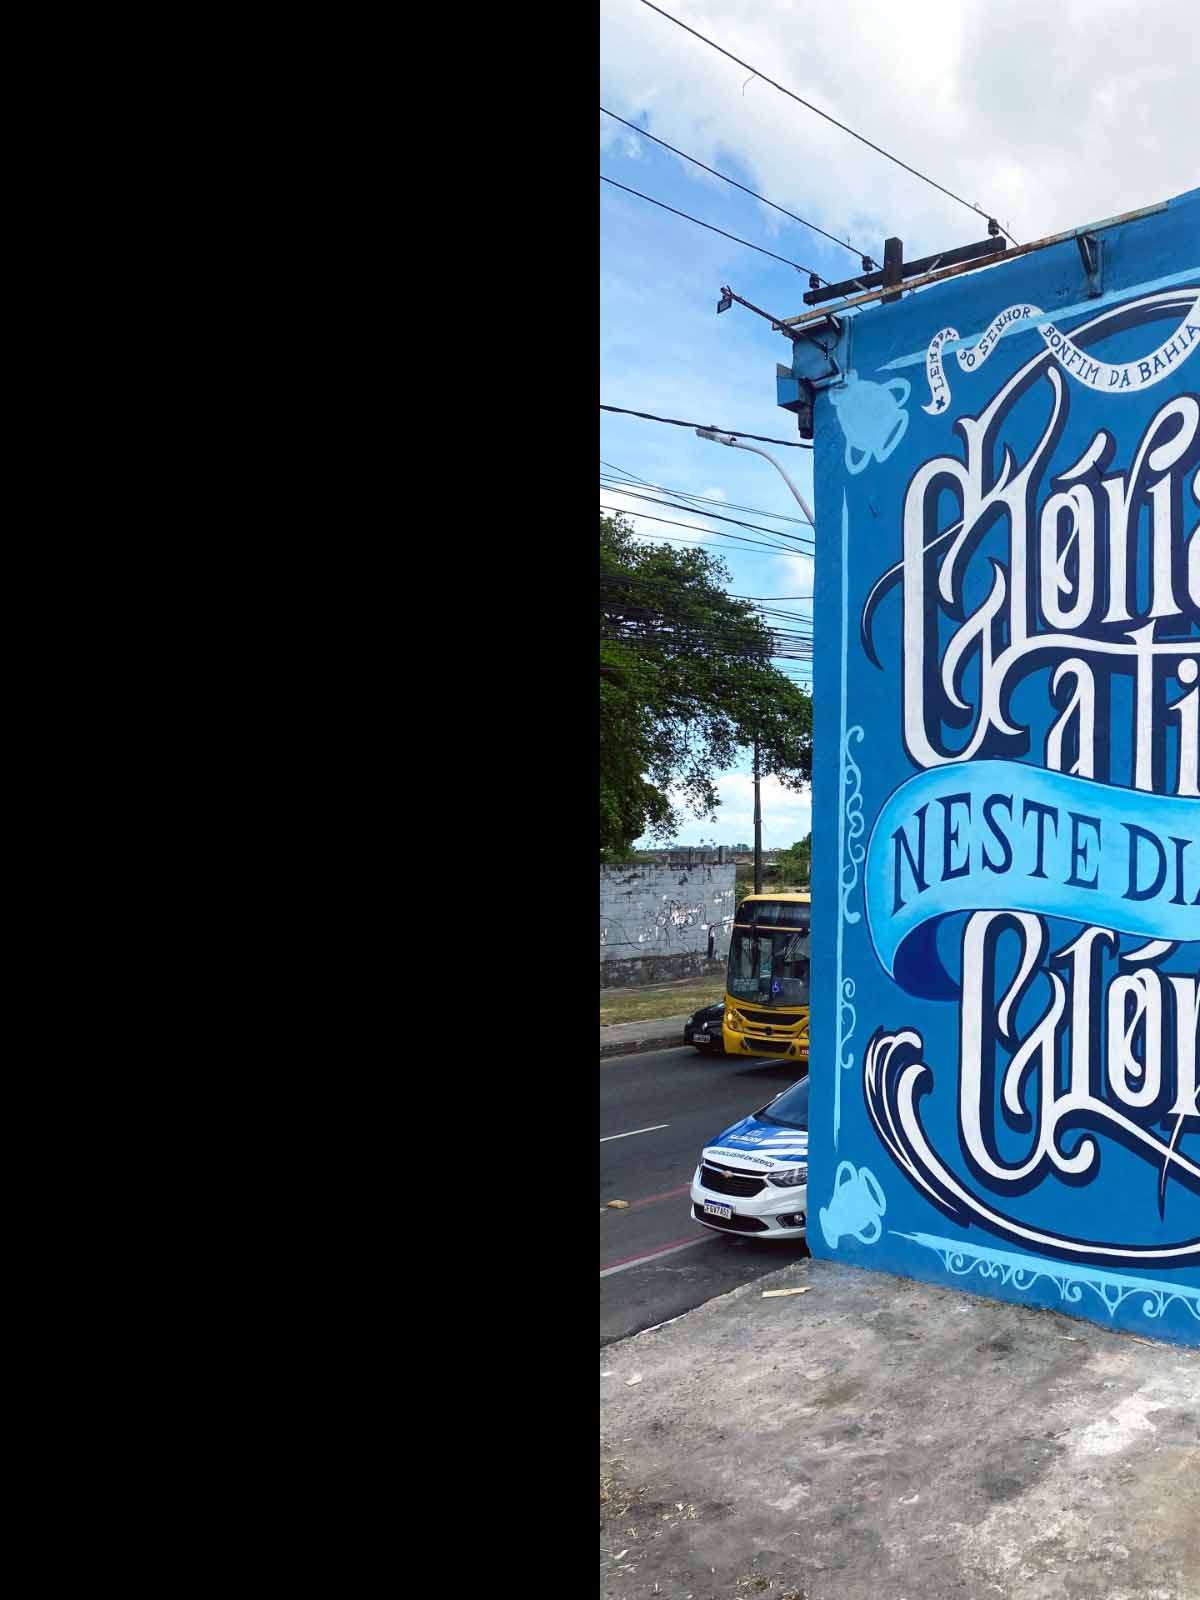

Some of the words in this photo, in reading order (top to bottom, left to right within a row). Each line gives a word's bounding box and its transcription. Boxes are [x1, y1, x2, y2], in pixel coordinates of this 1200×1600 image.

[978, 306, 1031, 356] SENHOR
[1044, 326, 1100, 385] BONFIM
[1107, 369, 1131, 388] DA
[890, 791, 1102, 918] NESTE
